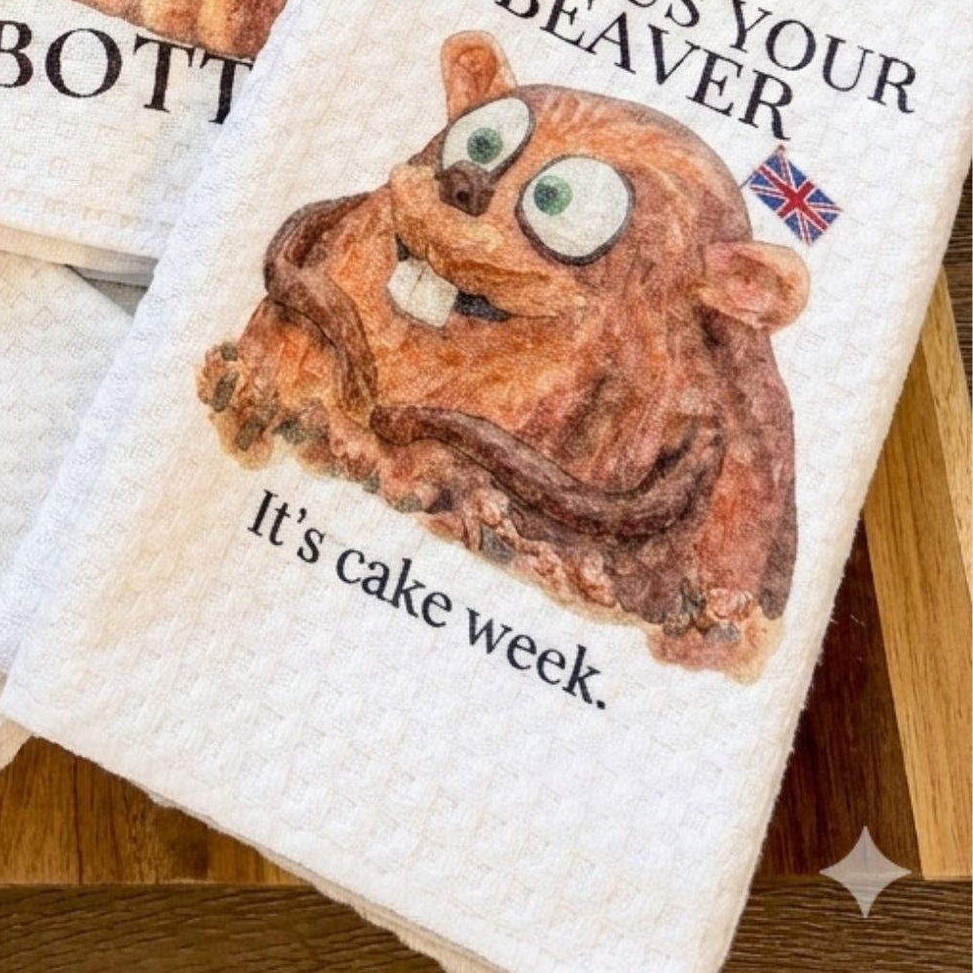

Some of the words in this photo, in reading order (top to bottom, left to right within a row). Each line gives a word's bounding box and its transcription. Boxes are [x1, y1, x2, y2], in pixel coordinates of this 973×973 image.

[247, 489, 326, 563] It’s
[336, 548, 452, 628] cake
[465, 607, 607, 710] week.
